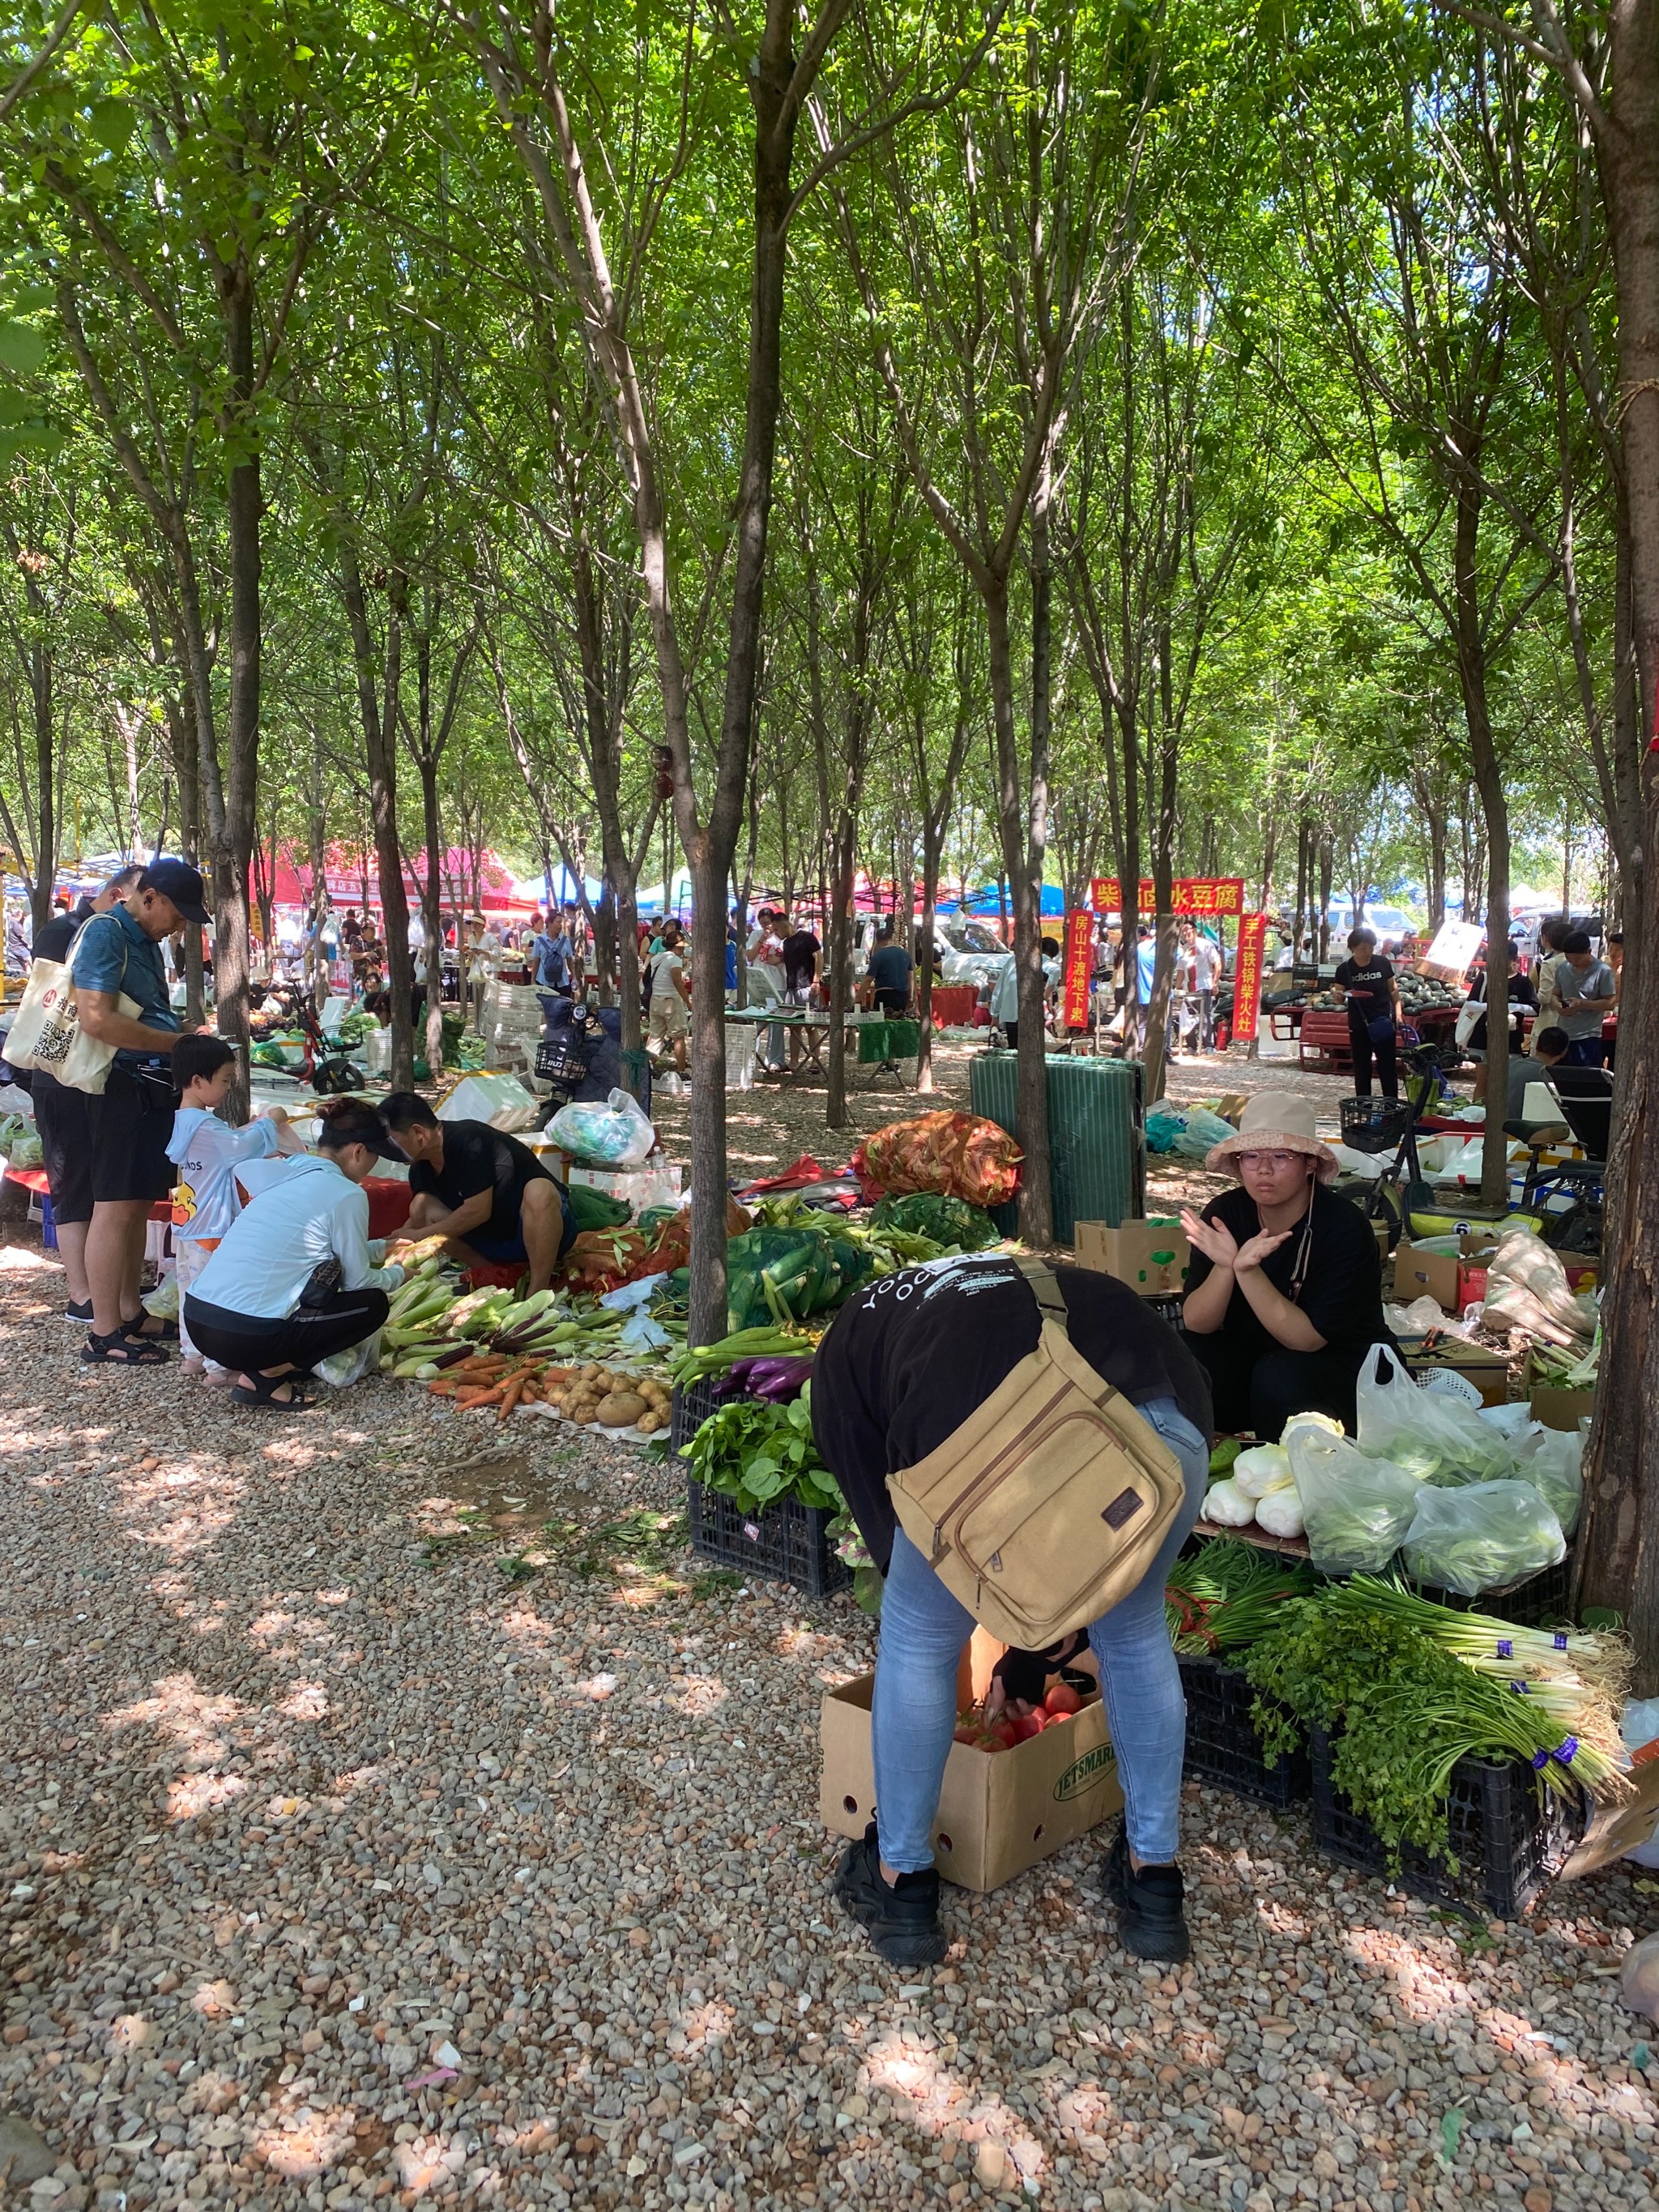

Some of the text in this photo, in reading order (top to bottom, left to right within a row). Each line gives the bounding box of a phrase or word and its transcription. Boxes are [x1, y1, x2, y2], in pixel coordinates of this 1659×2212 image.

[1097, 882, 1239, 909] 柴卤水豆腐
[1069, 915, 1089, 1022] 房山十渡地下泉
[1238, 917, 1260, 1033] 手工铁锅柴火灶
